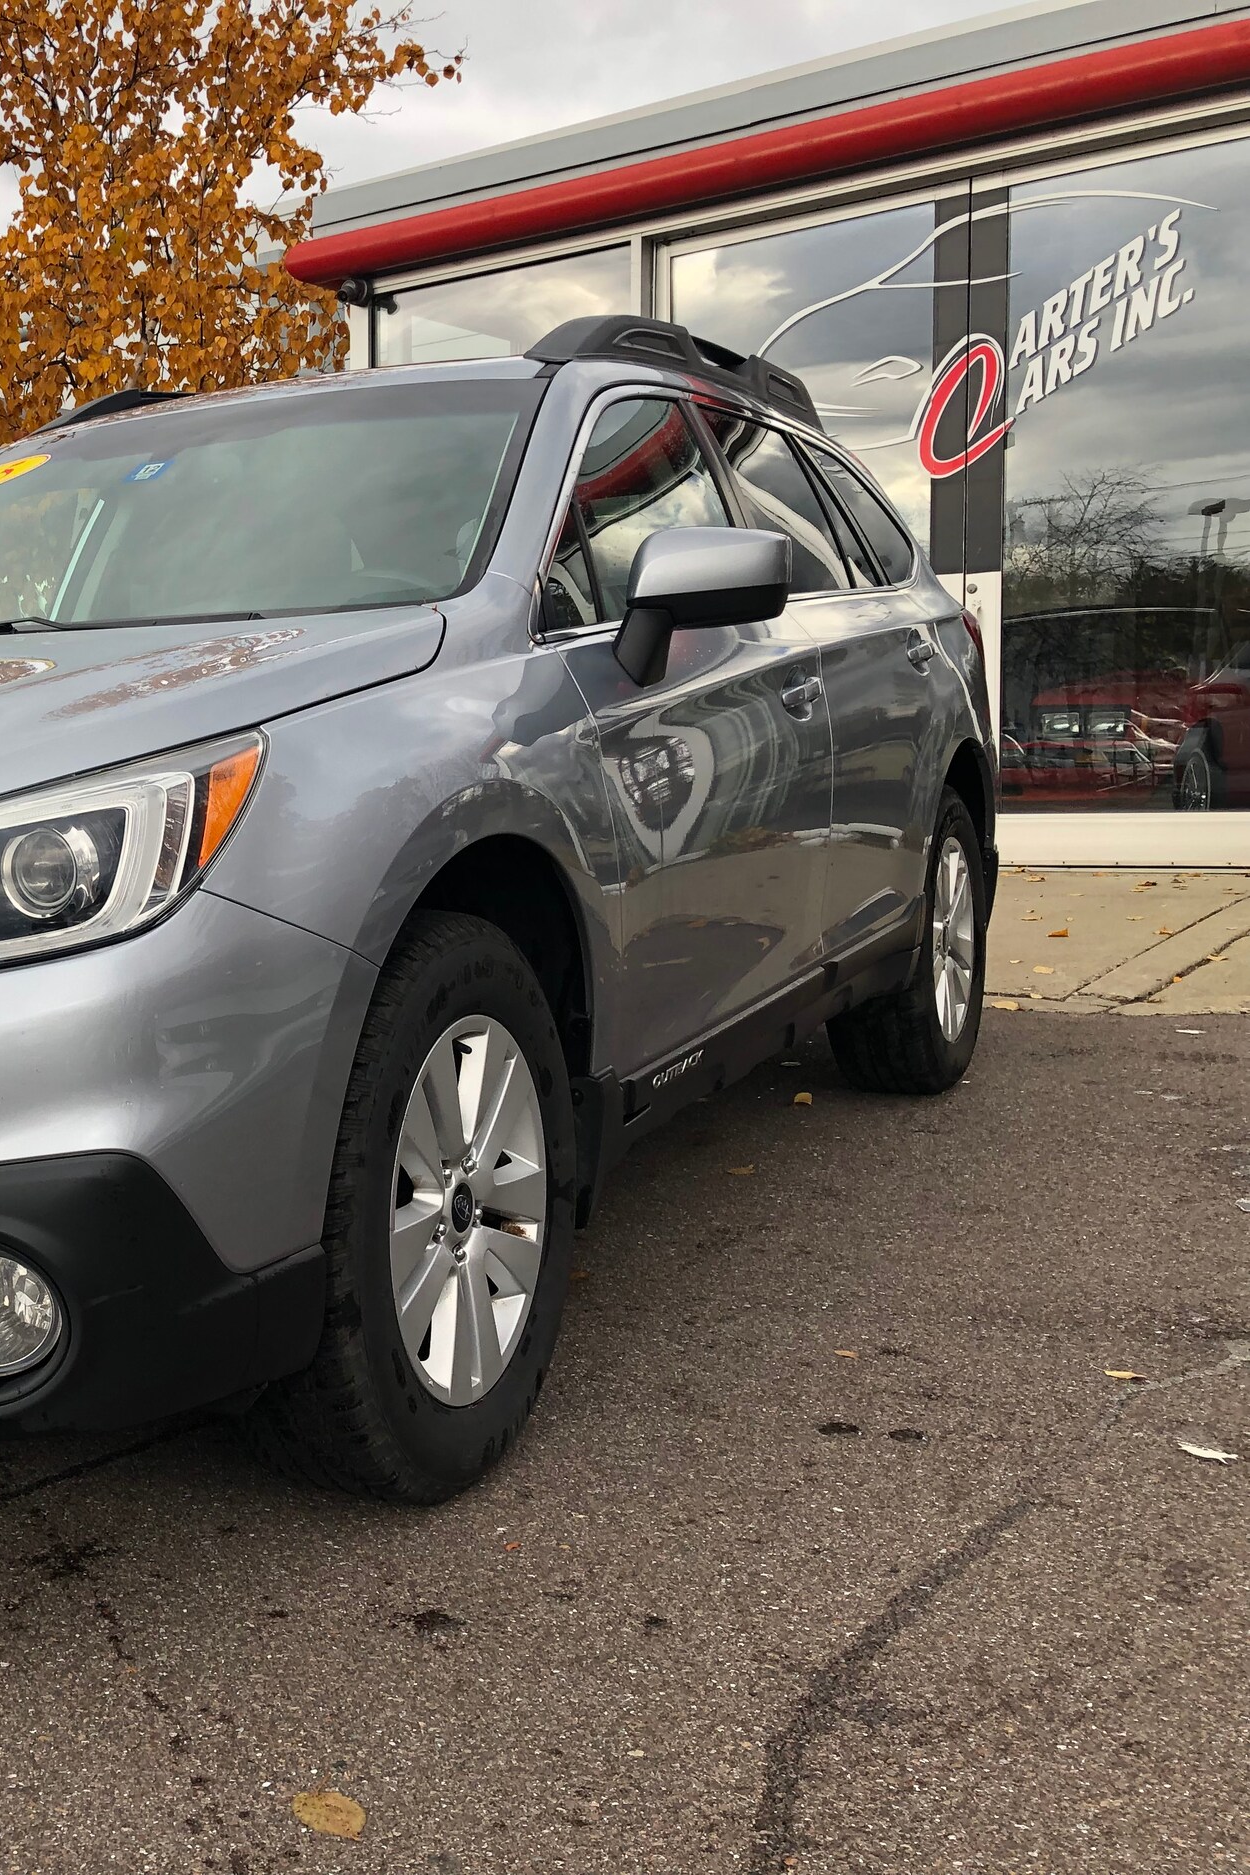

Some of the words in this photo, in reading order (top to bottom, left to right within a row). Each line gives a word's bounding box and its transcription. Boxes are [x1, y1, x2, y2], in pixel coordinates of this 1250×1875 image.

[1008, 207, 1182, 371] ARTER'S
[1015, 314, 1102, 415] ARS
[1109, 257, 1195, 353] INC.
